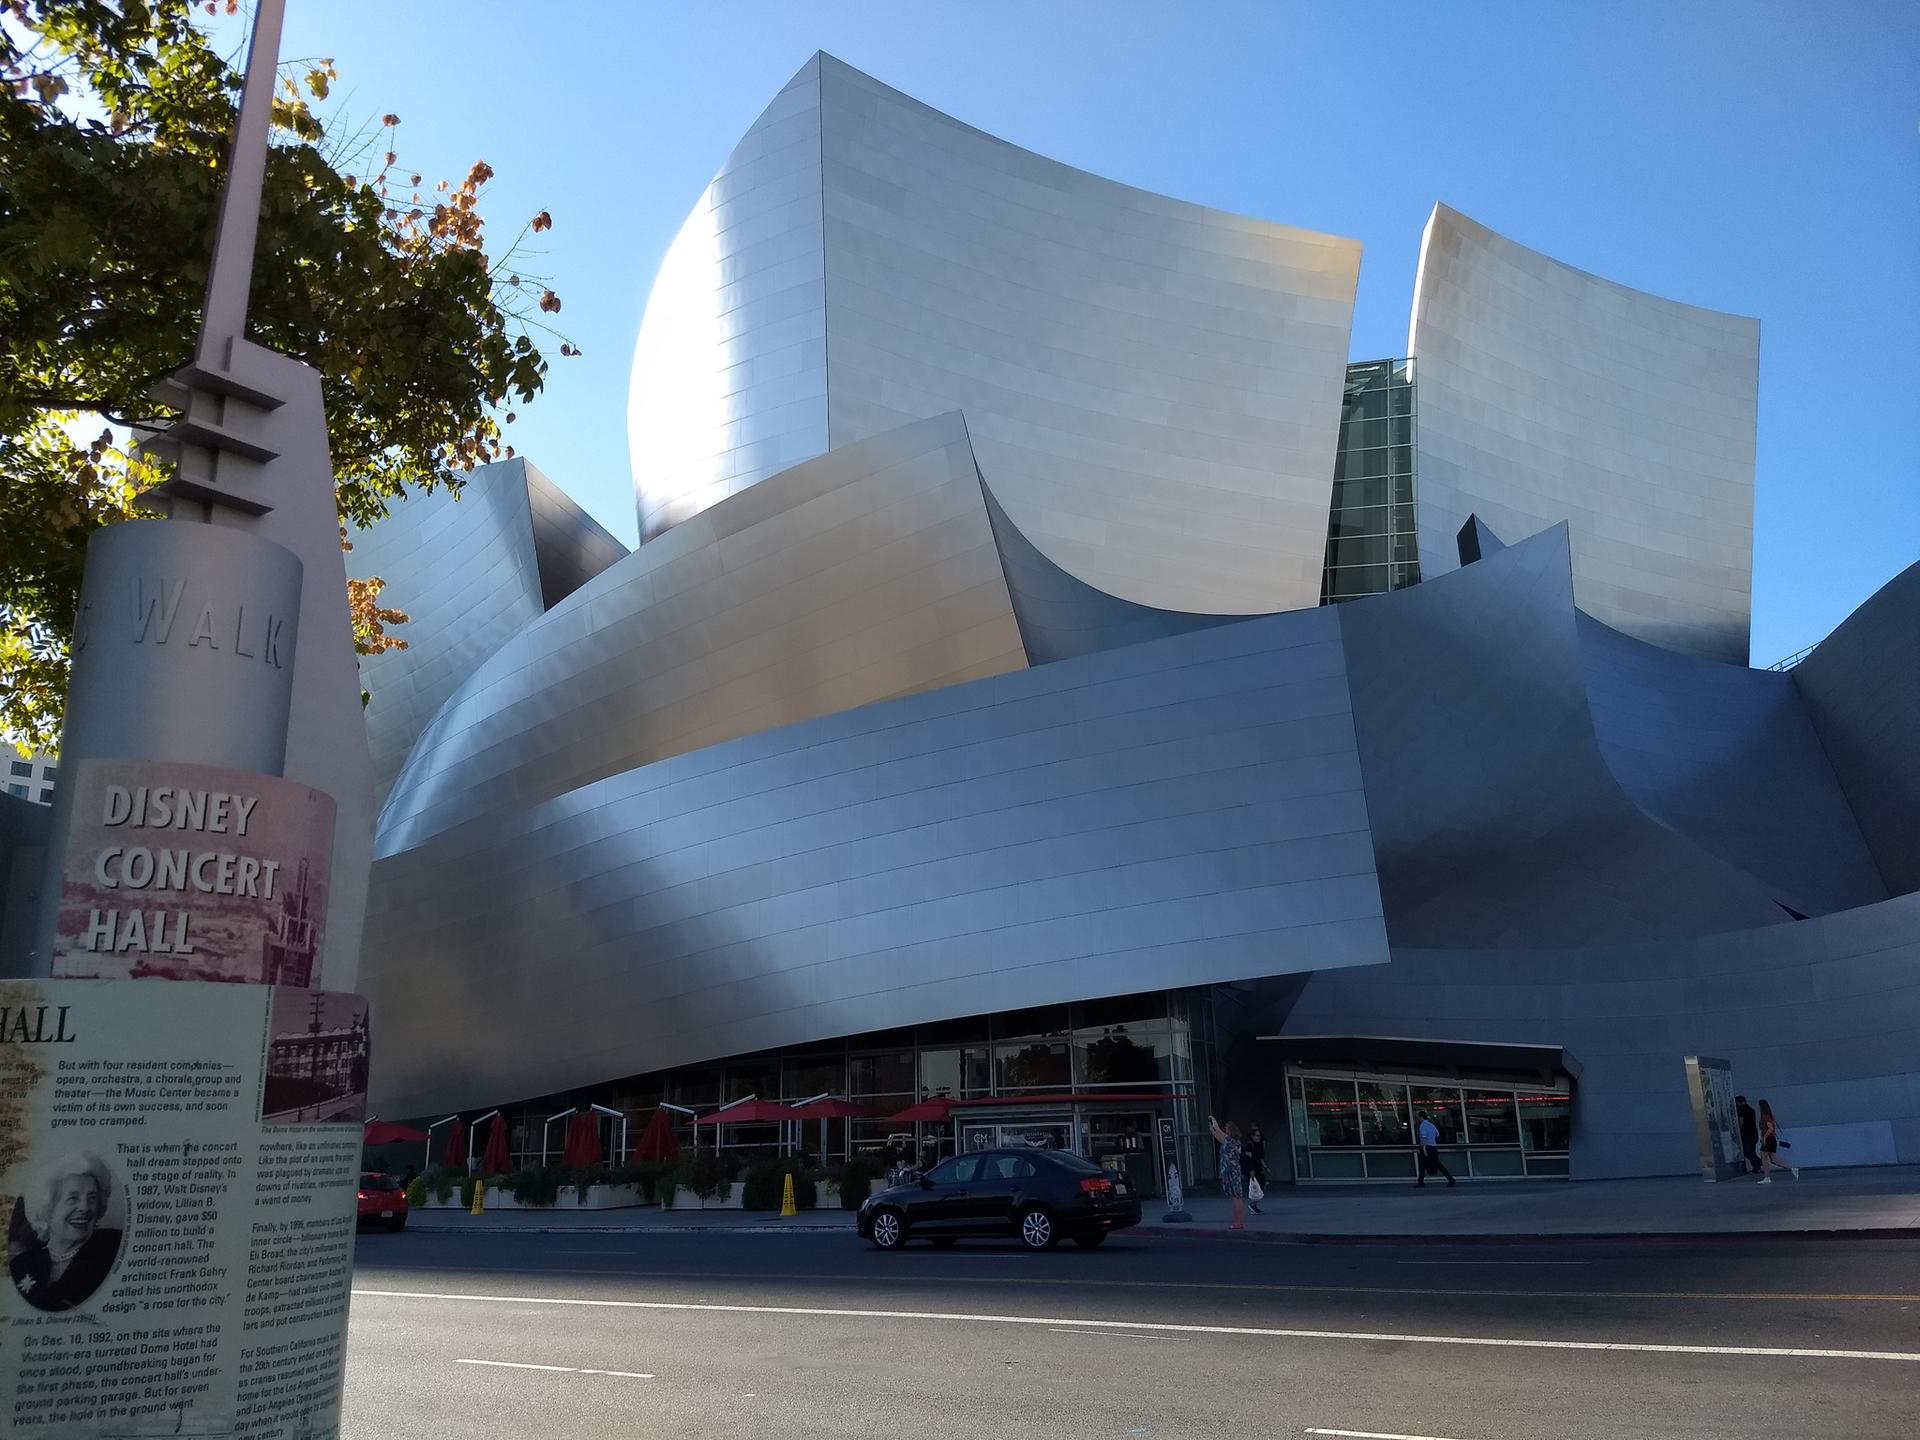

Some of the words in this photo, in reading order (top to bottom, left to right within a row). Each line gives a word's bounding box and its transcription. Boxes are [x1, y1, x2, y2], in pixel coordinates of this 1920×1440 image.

[132, 576, 284, 669] WALK
[103, 785, 259, 837] DISNEY
[95, 847, 281, 901] CONCERT
[86, 909, 195, 956] HALL
[58, 1060, 76, 1070] But
[78, 1060, 100, 1070] with
[103, 1060, 124, 1070] four
[126, 1060, 168, 1070] resident
[55, 1075, 89, 1086] opera,
[91, 1074, 143, 1085] orchestra,
[145, 1075, 152, 1084] a
[195, 1075, 223, 1086] group
[224, 1074, 242, 1084] and
[124, 1087, 156, 1098] Music
[159, 1087, 192, 1097] Center
[194, 1087, 231, 1097] became
[233, 1089, 239, 1097] a
[52, 1102, 83, 1112] victim
[85, 1102, 97, 1112] of
[98, 1102, 111, 1112] its
[113, 1103, 136, 1112] own
[138, 1102, 182, 1112] success,
[185, 1101, 204, 1111] and
[205, 1102, 228, 1111] soon
[50, 1118, 78, 1128] grew
[79, 1117, 97, 1126] too
[117, 1143, 140, 1153] That
[142, 1143, 151, 1153] is
[153, 1143, 180, 1153] when
[183, 1142, 199, 1153] the
[202, 1142, 237, 1152] concert
[126, 1157, 145, 1167] hall
[147, 1157, 180, 1167] dream
[182, 1156, 220, 1168] stepped
[222, 1156, 242, 1165] onto
[258, 1155, 274, 1165] Like
[275, 1155, 287, 1164] the
[132, 1171, 149, 1181] the
[151, 1172, 179, 1182] stage
[181, 1170, 192, 1180] of
[194, 1169, 225, 1181] reality.
[227, 1169, 236, 1178] In
[256, 1170, 274, 1179] was
[275, 1168, 303, 1180] plagued
[136, 1185, 161, 1196] 1987,
[163, 1184, 187, 1194] Walt
[255, 1183, 281, 1192] downs
[282, 1181, 291, 1191] of
[136, 1199, 173, 1210] widow,
[175, 1198, 204, 1208] Lillian
[206, 1196, 216, 1207] B.
[261, 1196, 282, 1205] want
[136, 1213, 173, 1225] Disney,
[175, 1213, 199, 1224] gave
[201, 1210, 218, 1221] $50
[134, 1227, 168, 1239] million
[170, 1227, 180, 1237] to
[183, 1225, 206, 1236] build
[208, 1226, 215, 1235] a
[251, 1223, 278, 1233] Finally,
[279, 1222, 288, 1232] by
[132, 1242, 171, 1253] concert
[173, 1240, 195, 1251] hall.
[197, 1239, 215, 1249] The
[287, 1247, 298, 1257] the
[127, 1253, 210, 1268] world-renowned
[121, 1271, 168, 1282] architect
[169, 1269, 197, 1279] Frank
[199, 1266, 228, 1278] Gehry
[248, 1264, 278, 1274] Richard
[247, 1278, 273, 1288] Center
[274, 1275, 295, 1285] board
[112, 1286, 144, 1298] called
[146, 1285, 161, 1296] his
[163, 1281, 219, 1294] unorthodox
[102, 1301, 136, 1314] design
[152, 1299, 175, 1310] rose
[176, 1298, 192, 1308] for
[192, 1296, 207, 1307] the
[245, 1293, 256, 1303] de
[243, 1321, 259, 1331] lars
[260, 1319, 274, 1329] and
[276, 1316, 288, 1328] put
[23, 1336, 39, 1347] On
[88, 1332, 113, 1343] 1992,
[116, 1332, 130, 1342] on
[132, 1330, 149, 1340] the
[152, 1327, 170, 1339] site
[172, 1326, 204, 1337] where
[206, 1323, 221, 1333] the
[21, 1350, 92, 1363] Victorian-era
[95, 1345, 137, 1358] turreted
[140, 1343, 170, 1354] Dome
[172, 1340, 198, 1351] Hotel
[200, 1338, 218, 1348] had
[240, 1348, 255, 1359] For
[255, 1344, 288, 1357] Southern
[19, 1368, 46, 1379] once
[49, 1364, 83, 1377] stood,
[85, 1359, 168, 1376] groundbreaking
[170, 1356, 200, 1367] began
[203, 1353, 217, 1362] for
[239, 1364, 252, 1374] the
[254, 1361, 270, 1372] 20th
[272, 1357, 299, 1368] century
[37, 1382, 60, 1393] first
[61, 1380, 98, 1392] phase,
[101, 1377, 118, 1388] the
[121, 1376, 161, 1386] concert
[191, 1367, 222, 1379] under-
[56, 1395, 98, 1408] parking
[101, 1391, 141, 1405] garage.
[144, 1387, 161, 1399] But
[164, 1385, 179, 1396] for
[181, 1383, 209, 1394] seven
[237, 1391, 259, 1402] home
[261, 1388, 273, 1398] for
[273, 1385, 285, 1395] the
[285, 1382, 297, 1393] Los
[49, 1411, 67, 1423] the
[96, 1407, 106, 1419] in
[110, 1406, 127, 1417] the
[130, 1401, 167, 1417] ground
[169, 1399, 194, 1410] went
[235, 1407, 252, 1417] and
[253, 1403, 266, 1414] Los
